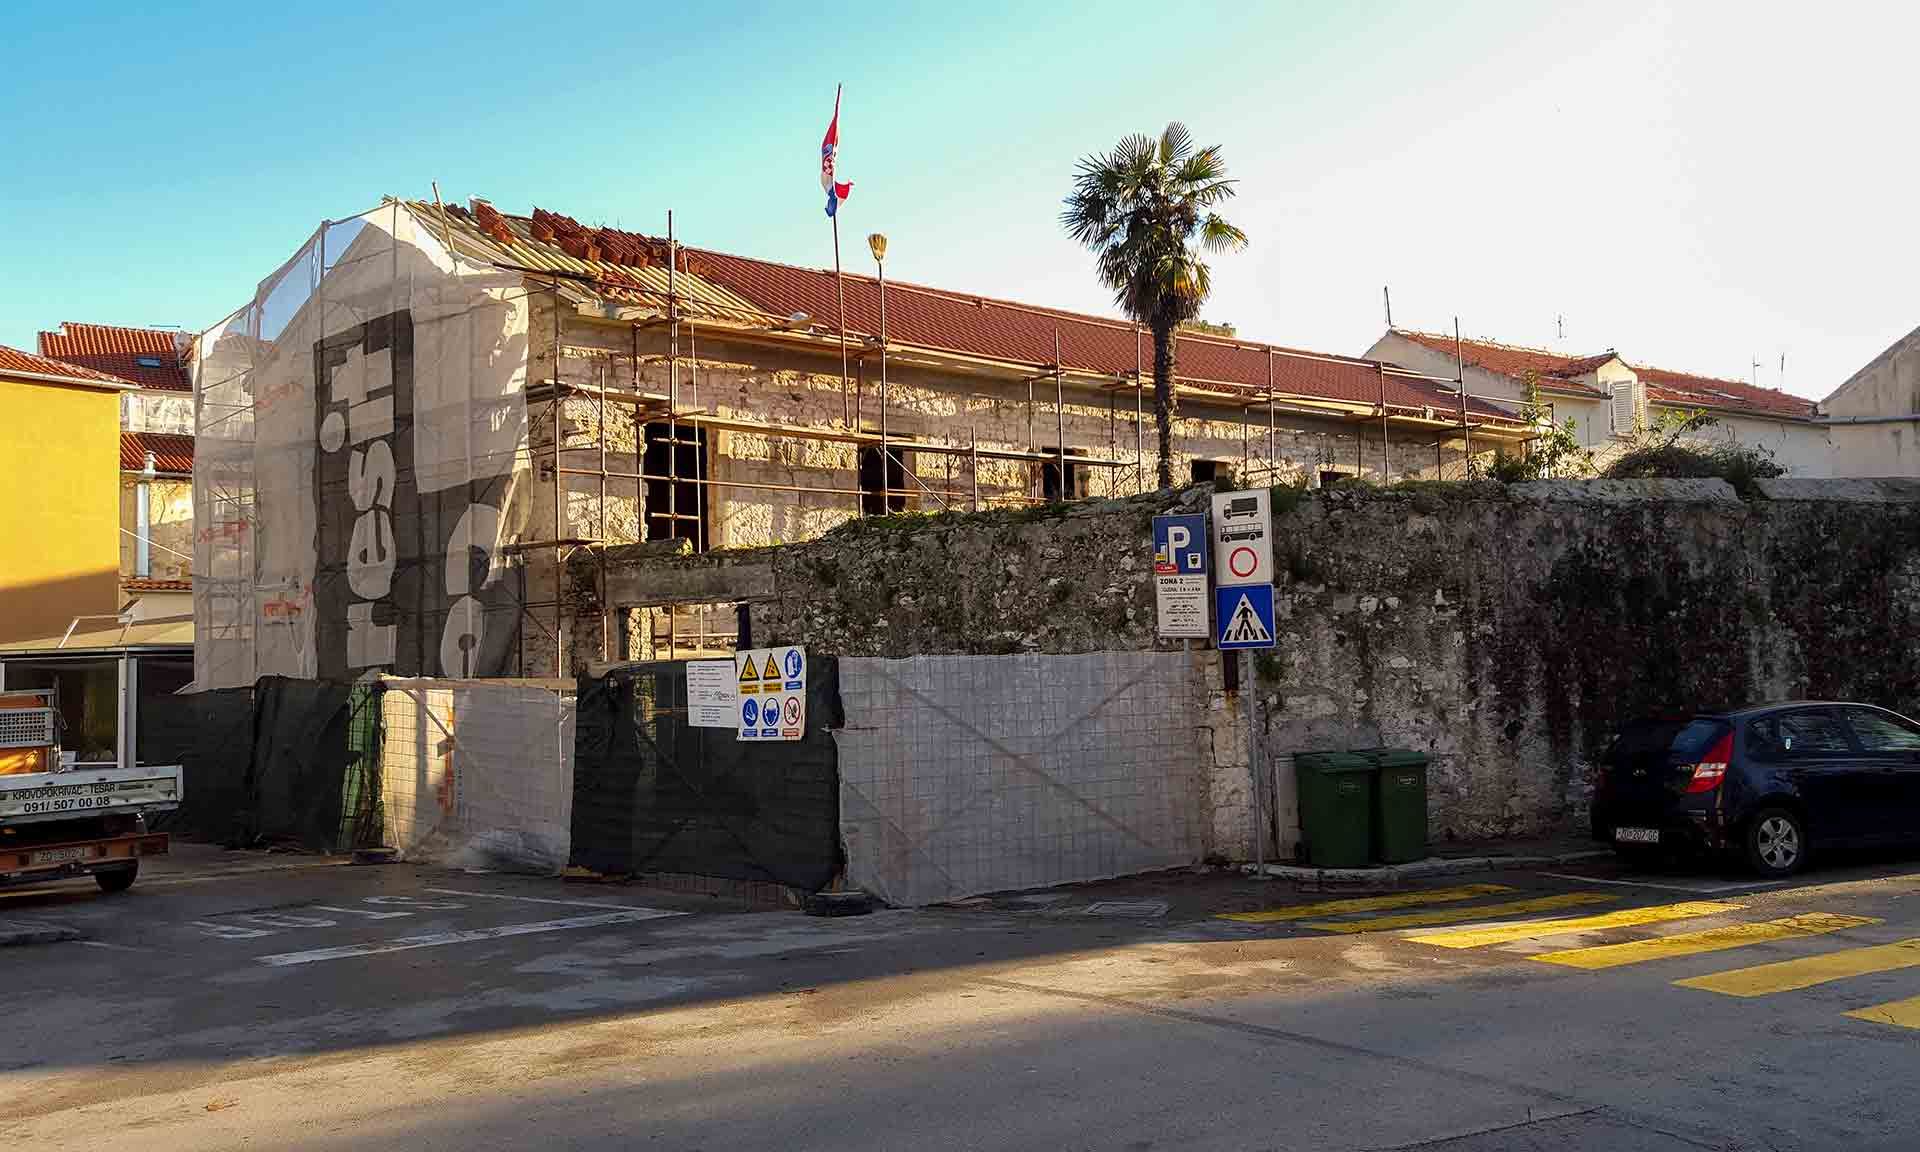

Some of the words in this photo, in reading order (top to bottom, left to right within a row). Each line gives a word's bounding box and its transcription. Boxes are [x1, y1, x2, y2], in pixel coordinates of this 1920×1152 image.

[320, 339, 397, 681] resit
[1167, 526, 1191, 565] P
[24, 801, 50, 812] 091/
[54, 799, 74, 810] 507
[79, 798, 93, 807] 00
[96, 796, 110, 806] 08
